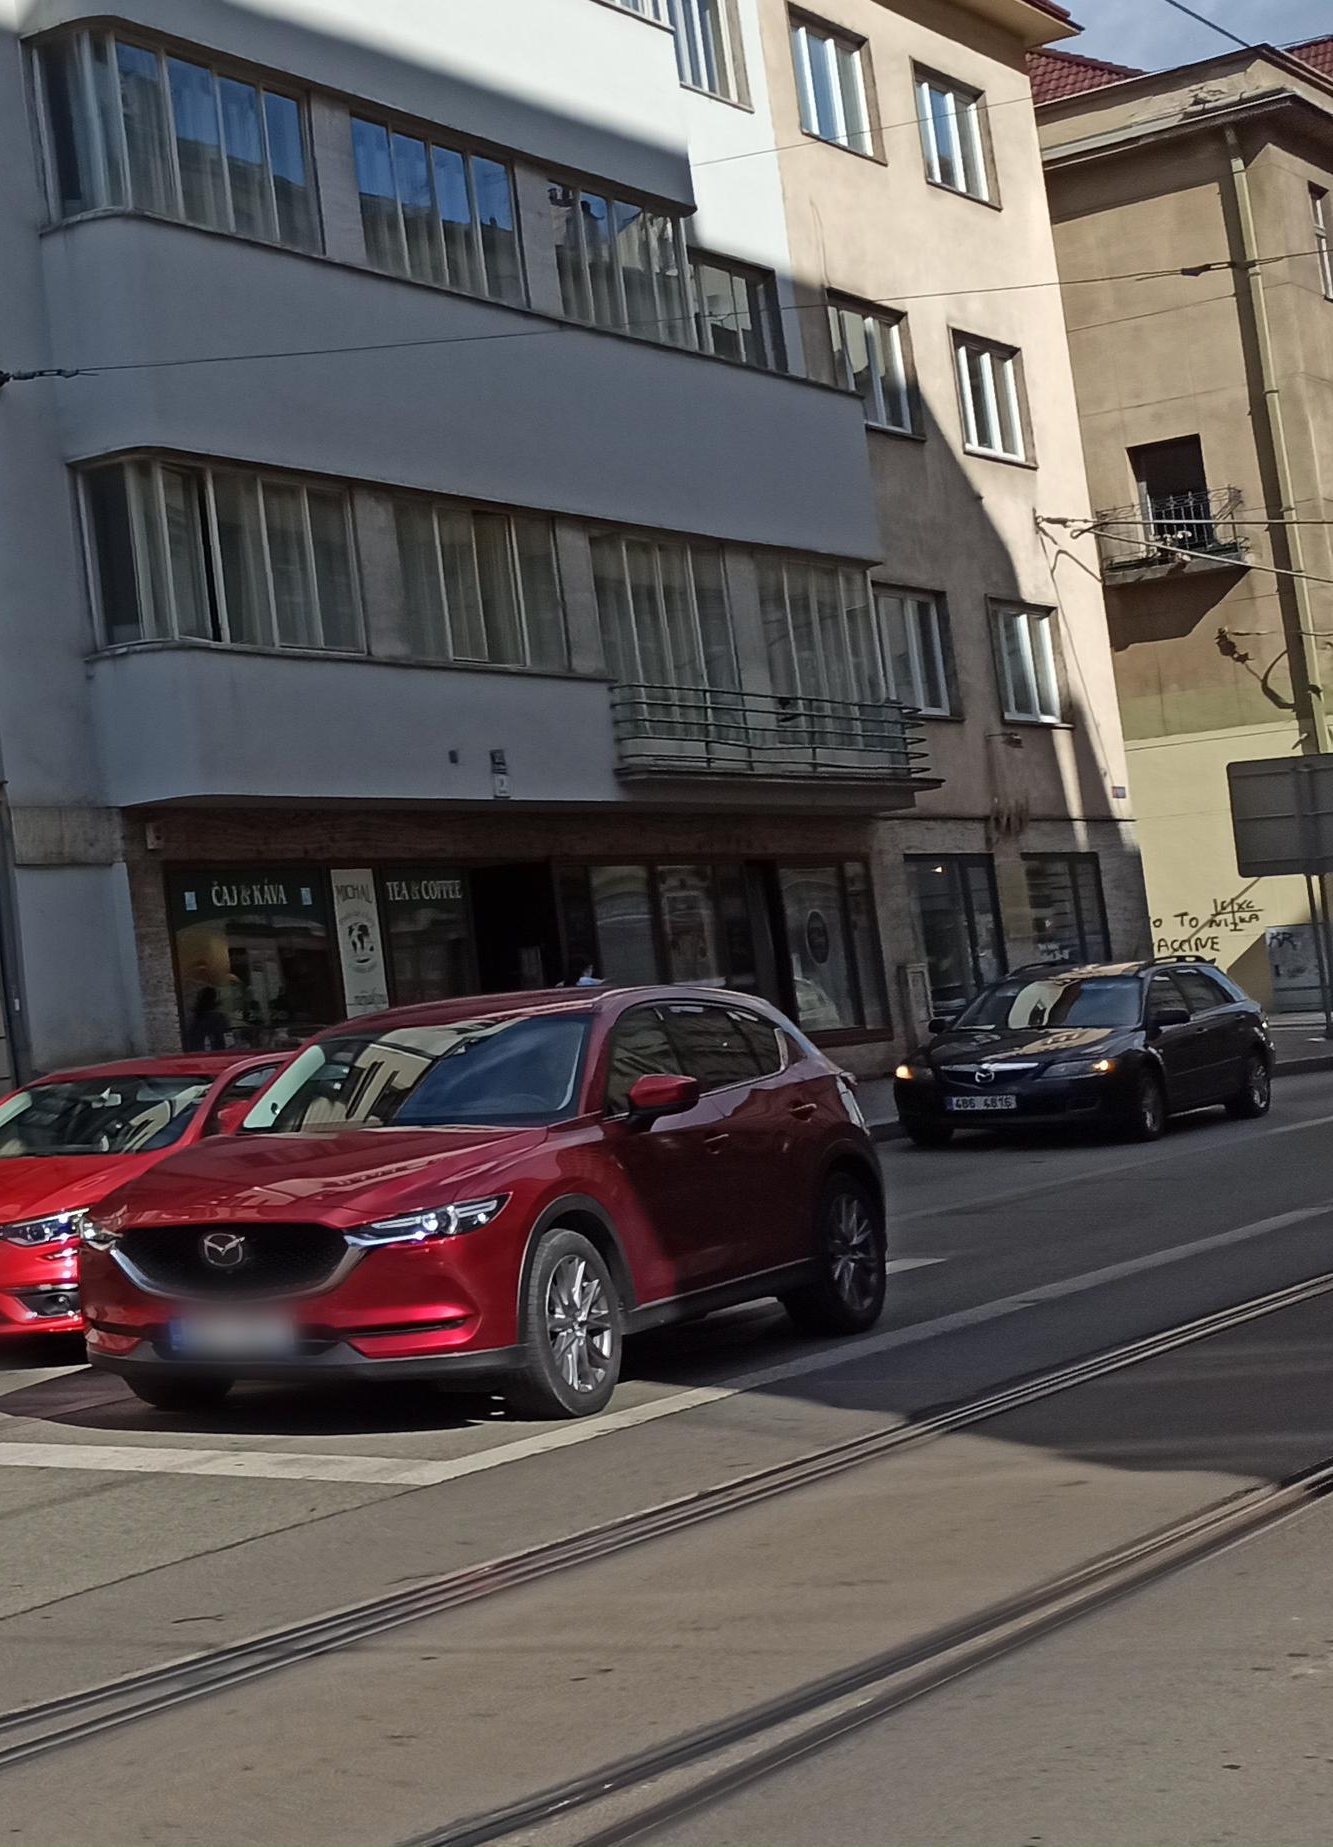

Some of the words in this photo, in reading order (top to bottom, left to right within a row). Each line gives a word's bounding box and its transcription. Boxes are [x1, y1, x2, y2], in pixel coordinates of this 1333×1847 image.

[211, 881, 239, 907] ČAJ
[252, 879, 288, 906] KÁVA
[386, 881, 410, 901] TEA
[421, 880, 463, 900] COFFEE
[1173, 911, 1199, 929] TO
[1154, 936, 1221, 953] ACCINE
